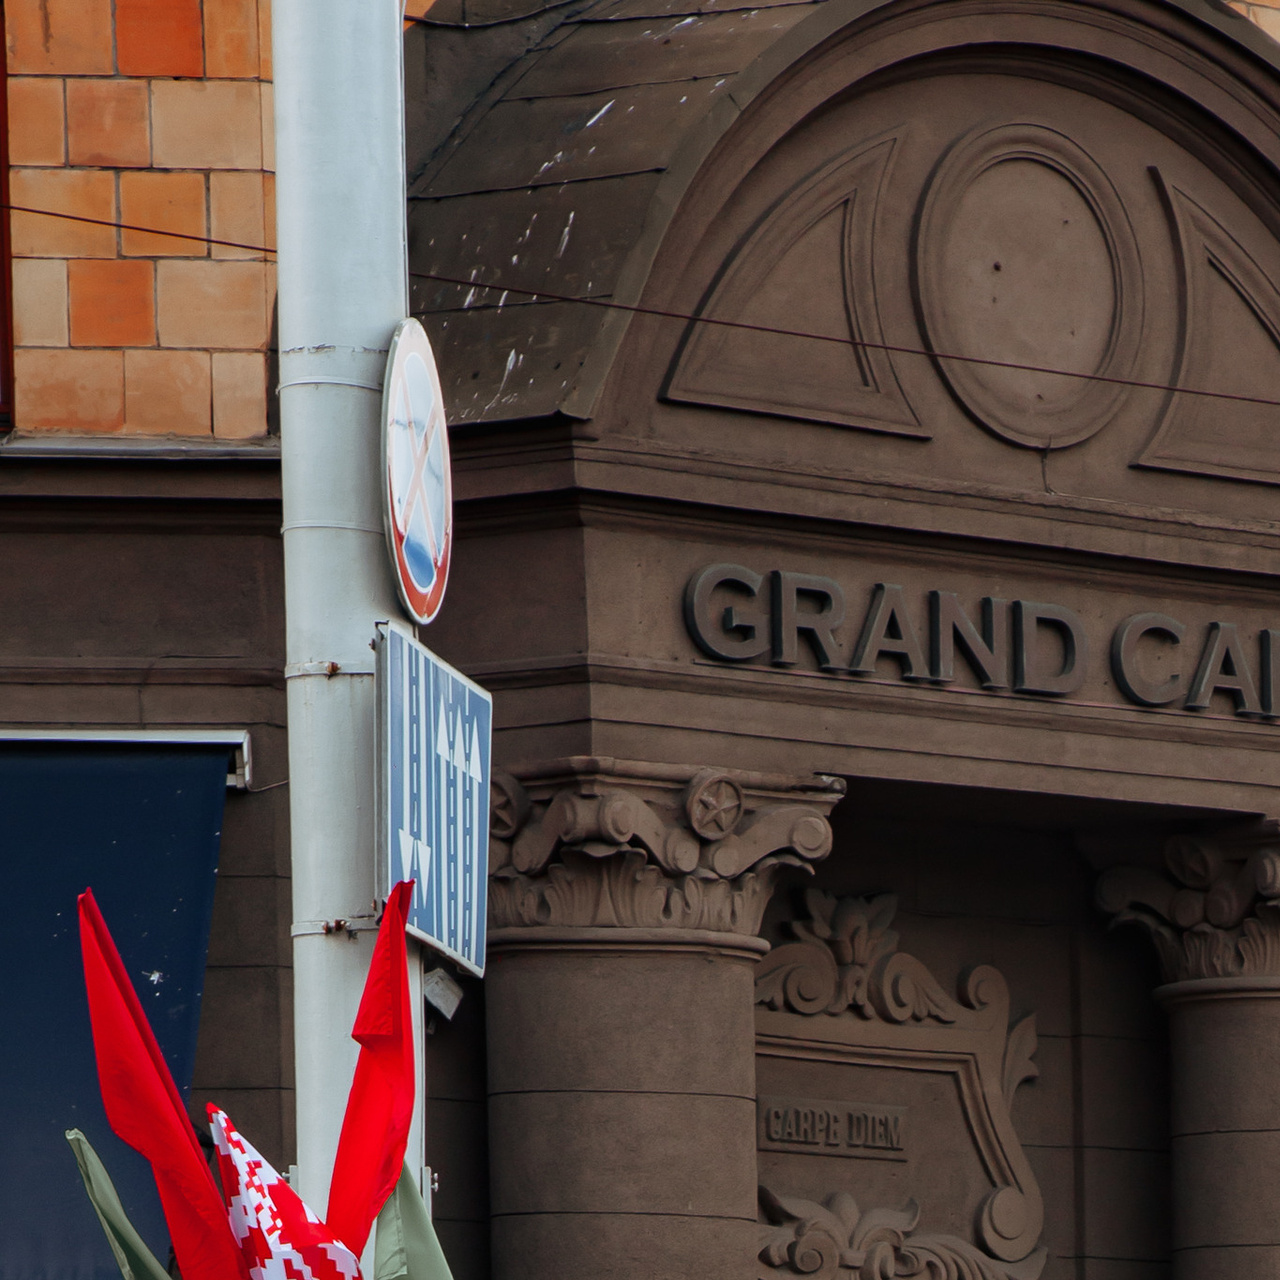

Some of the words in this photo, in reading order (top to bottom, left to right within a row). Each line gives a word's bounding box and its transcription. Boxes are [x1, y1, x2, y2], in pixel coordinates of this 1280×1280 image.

[684, 563, 1088, 699] GRAND
[765, 1107, 840, 1147] CARPE
[846, 1112, 905, 1151] DIEM
